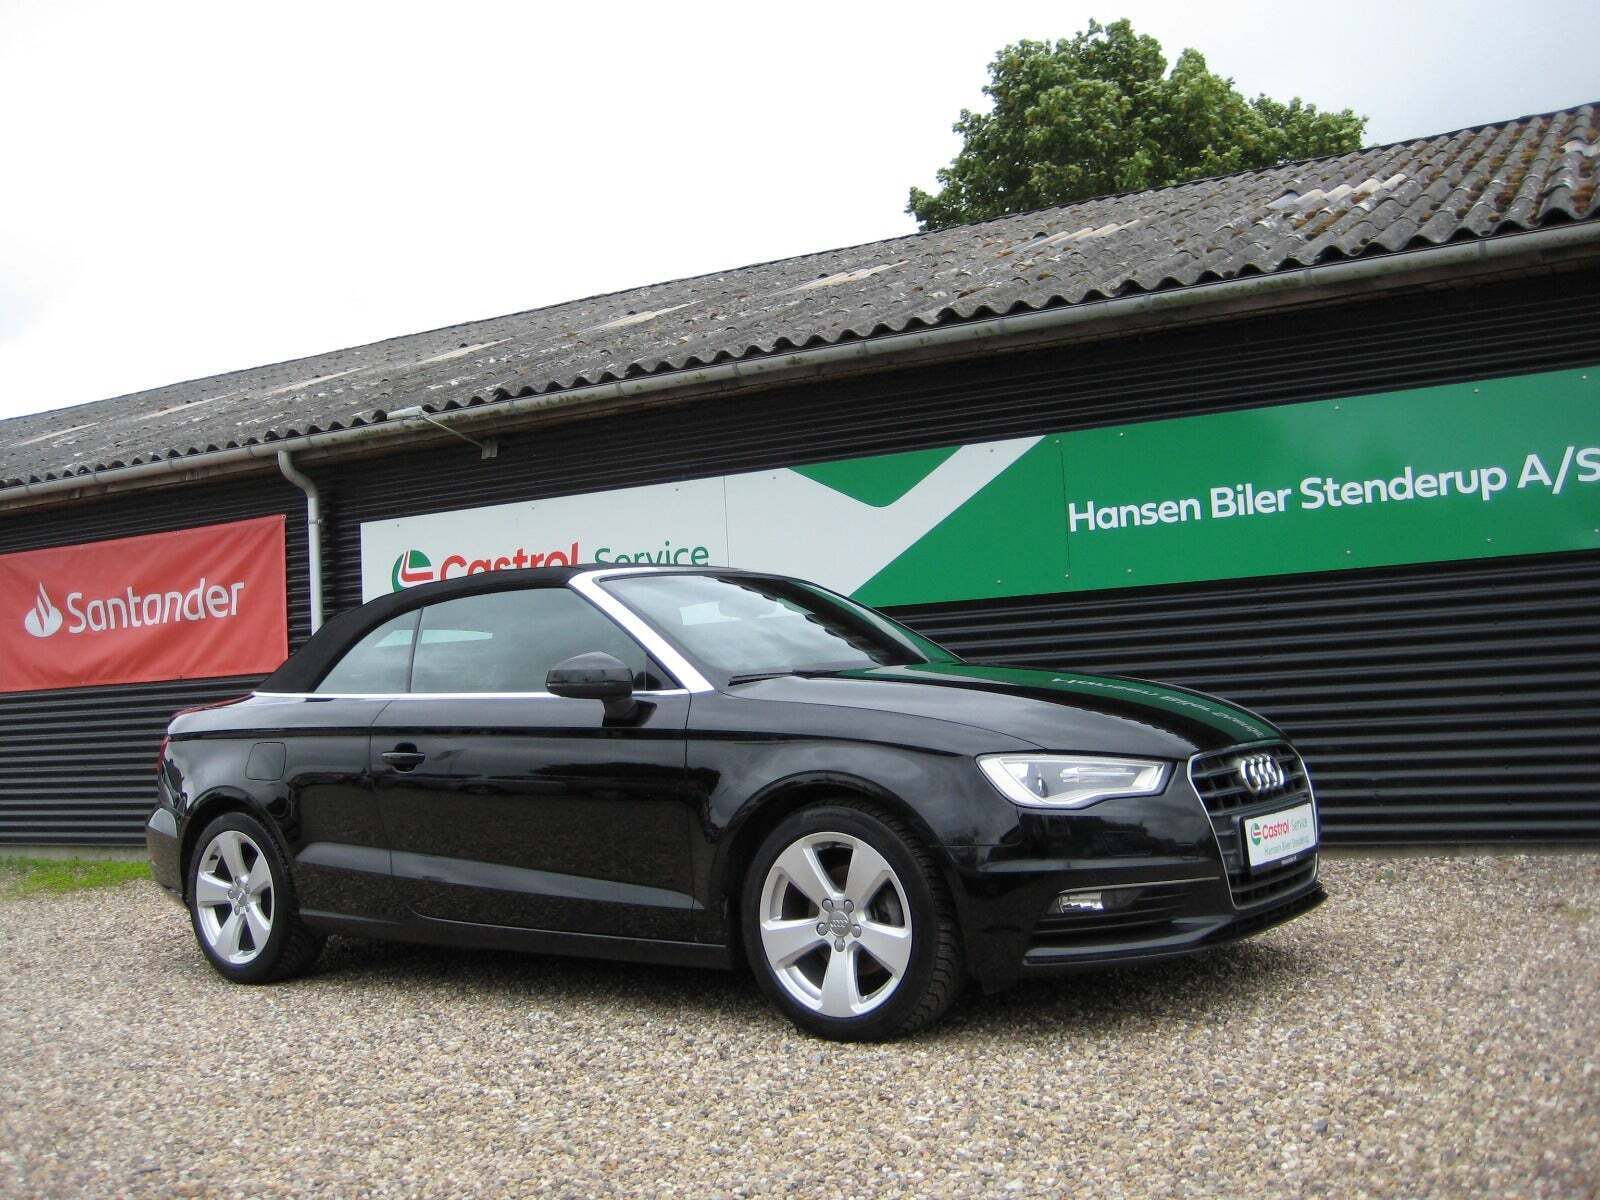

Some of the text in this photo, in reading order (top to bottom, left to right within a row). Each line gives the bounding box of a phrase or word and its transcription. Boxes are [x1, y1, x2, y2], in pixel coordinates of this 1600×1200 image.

[1068, 446, 1600, 532] Hansen Biler Stenderup A/S
[67, 577, 244, 633] Santander
[1262, 819, 1290, 839] Castrol
